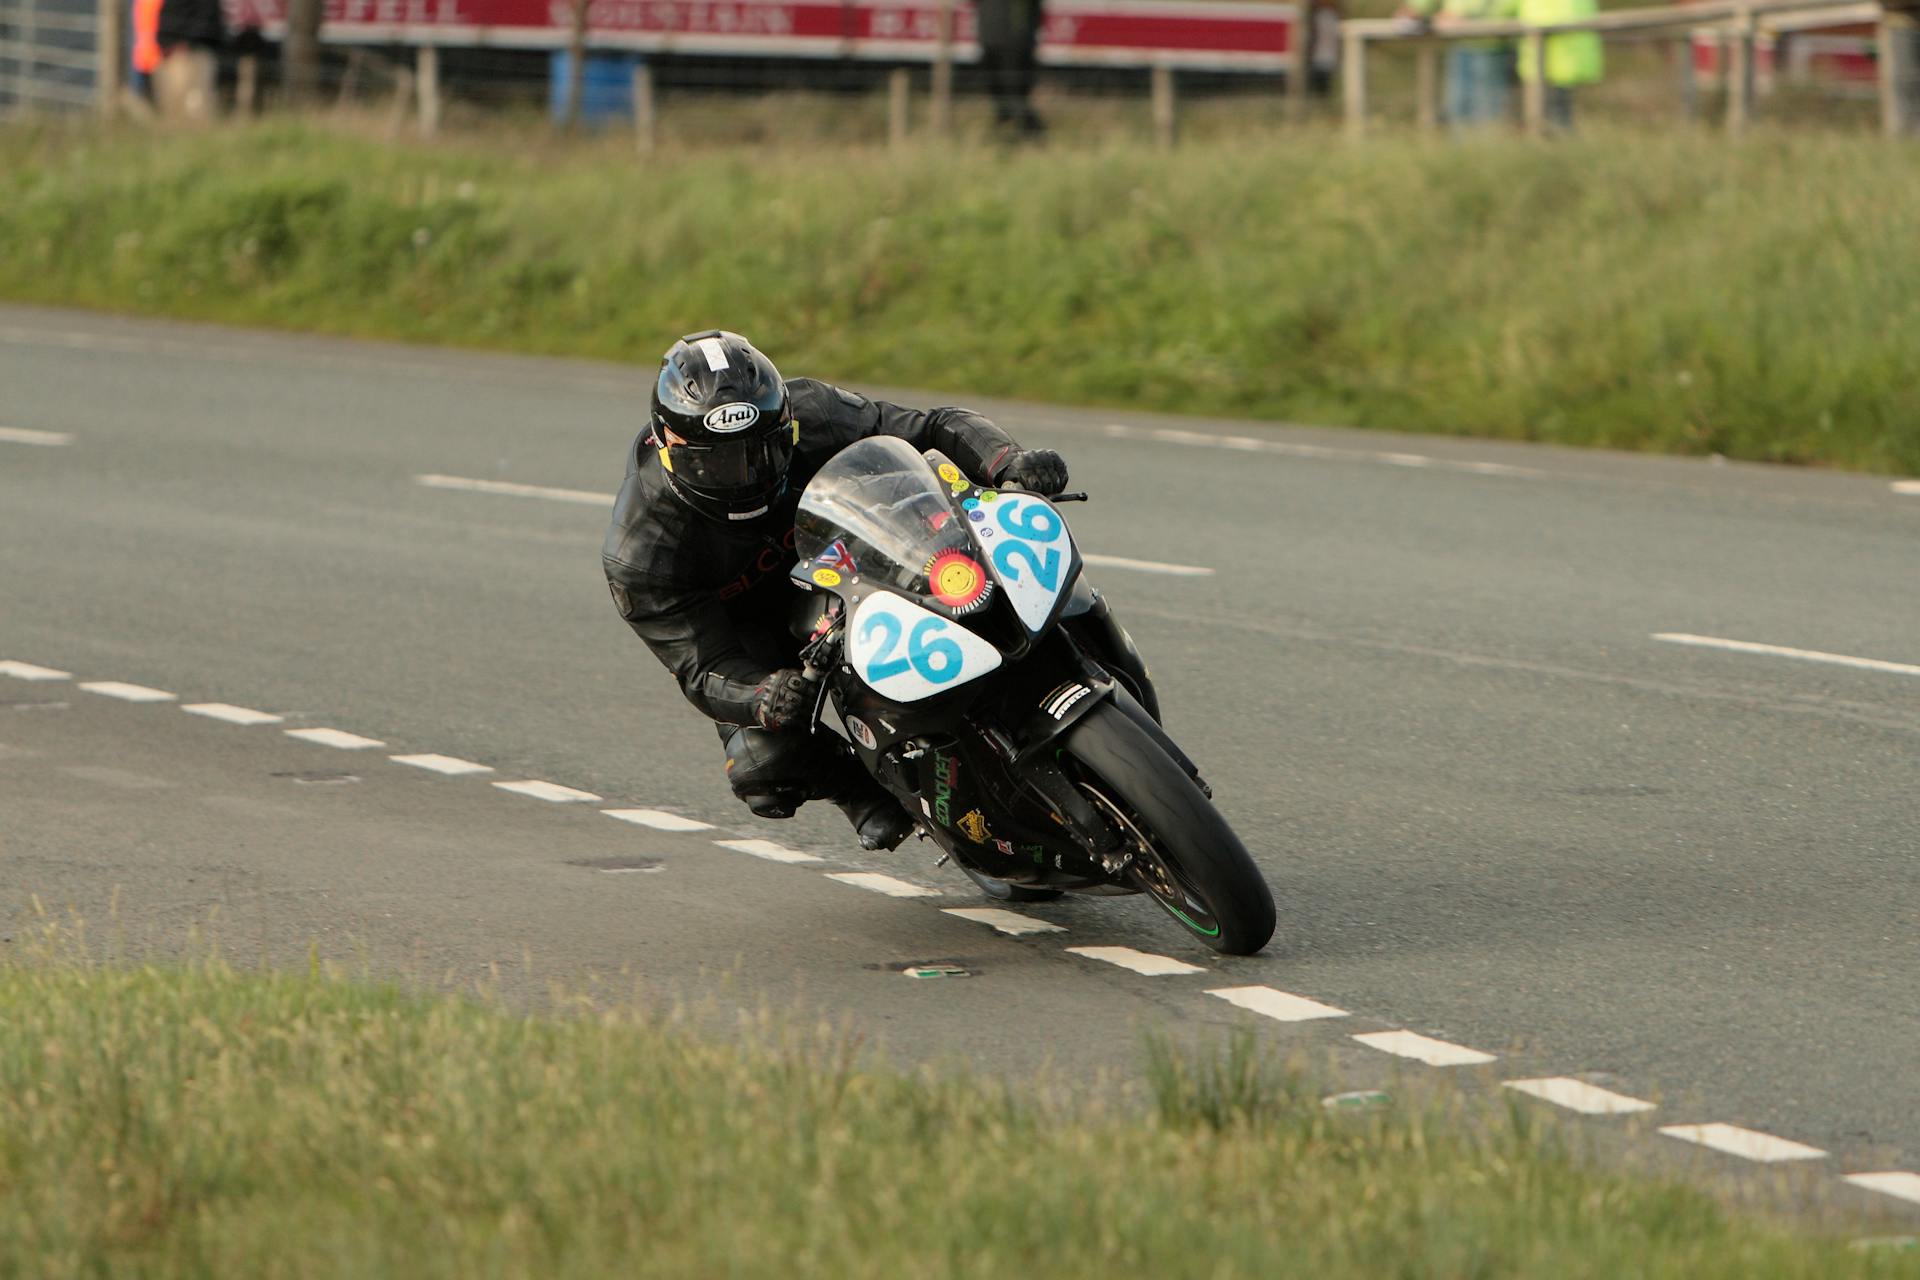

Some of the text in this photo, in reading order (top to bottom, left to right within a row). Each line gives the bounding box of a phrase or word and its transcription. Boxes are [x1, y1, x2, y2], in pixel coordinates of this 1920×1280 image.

[710, 406, 752, 426] Arai
[992, 499, 1062, 594] 26
[859, 611, 964, 684] 26
